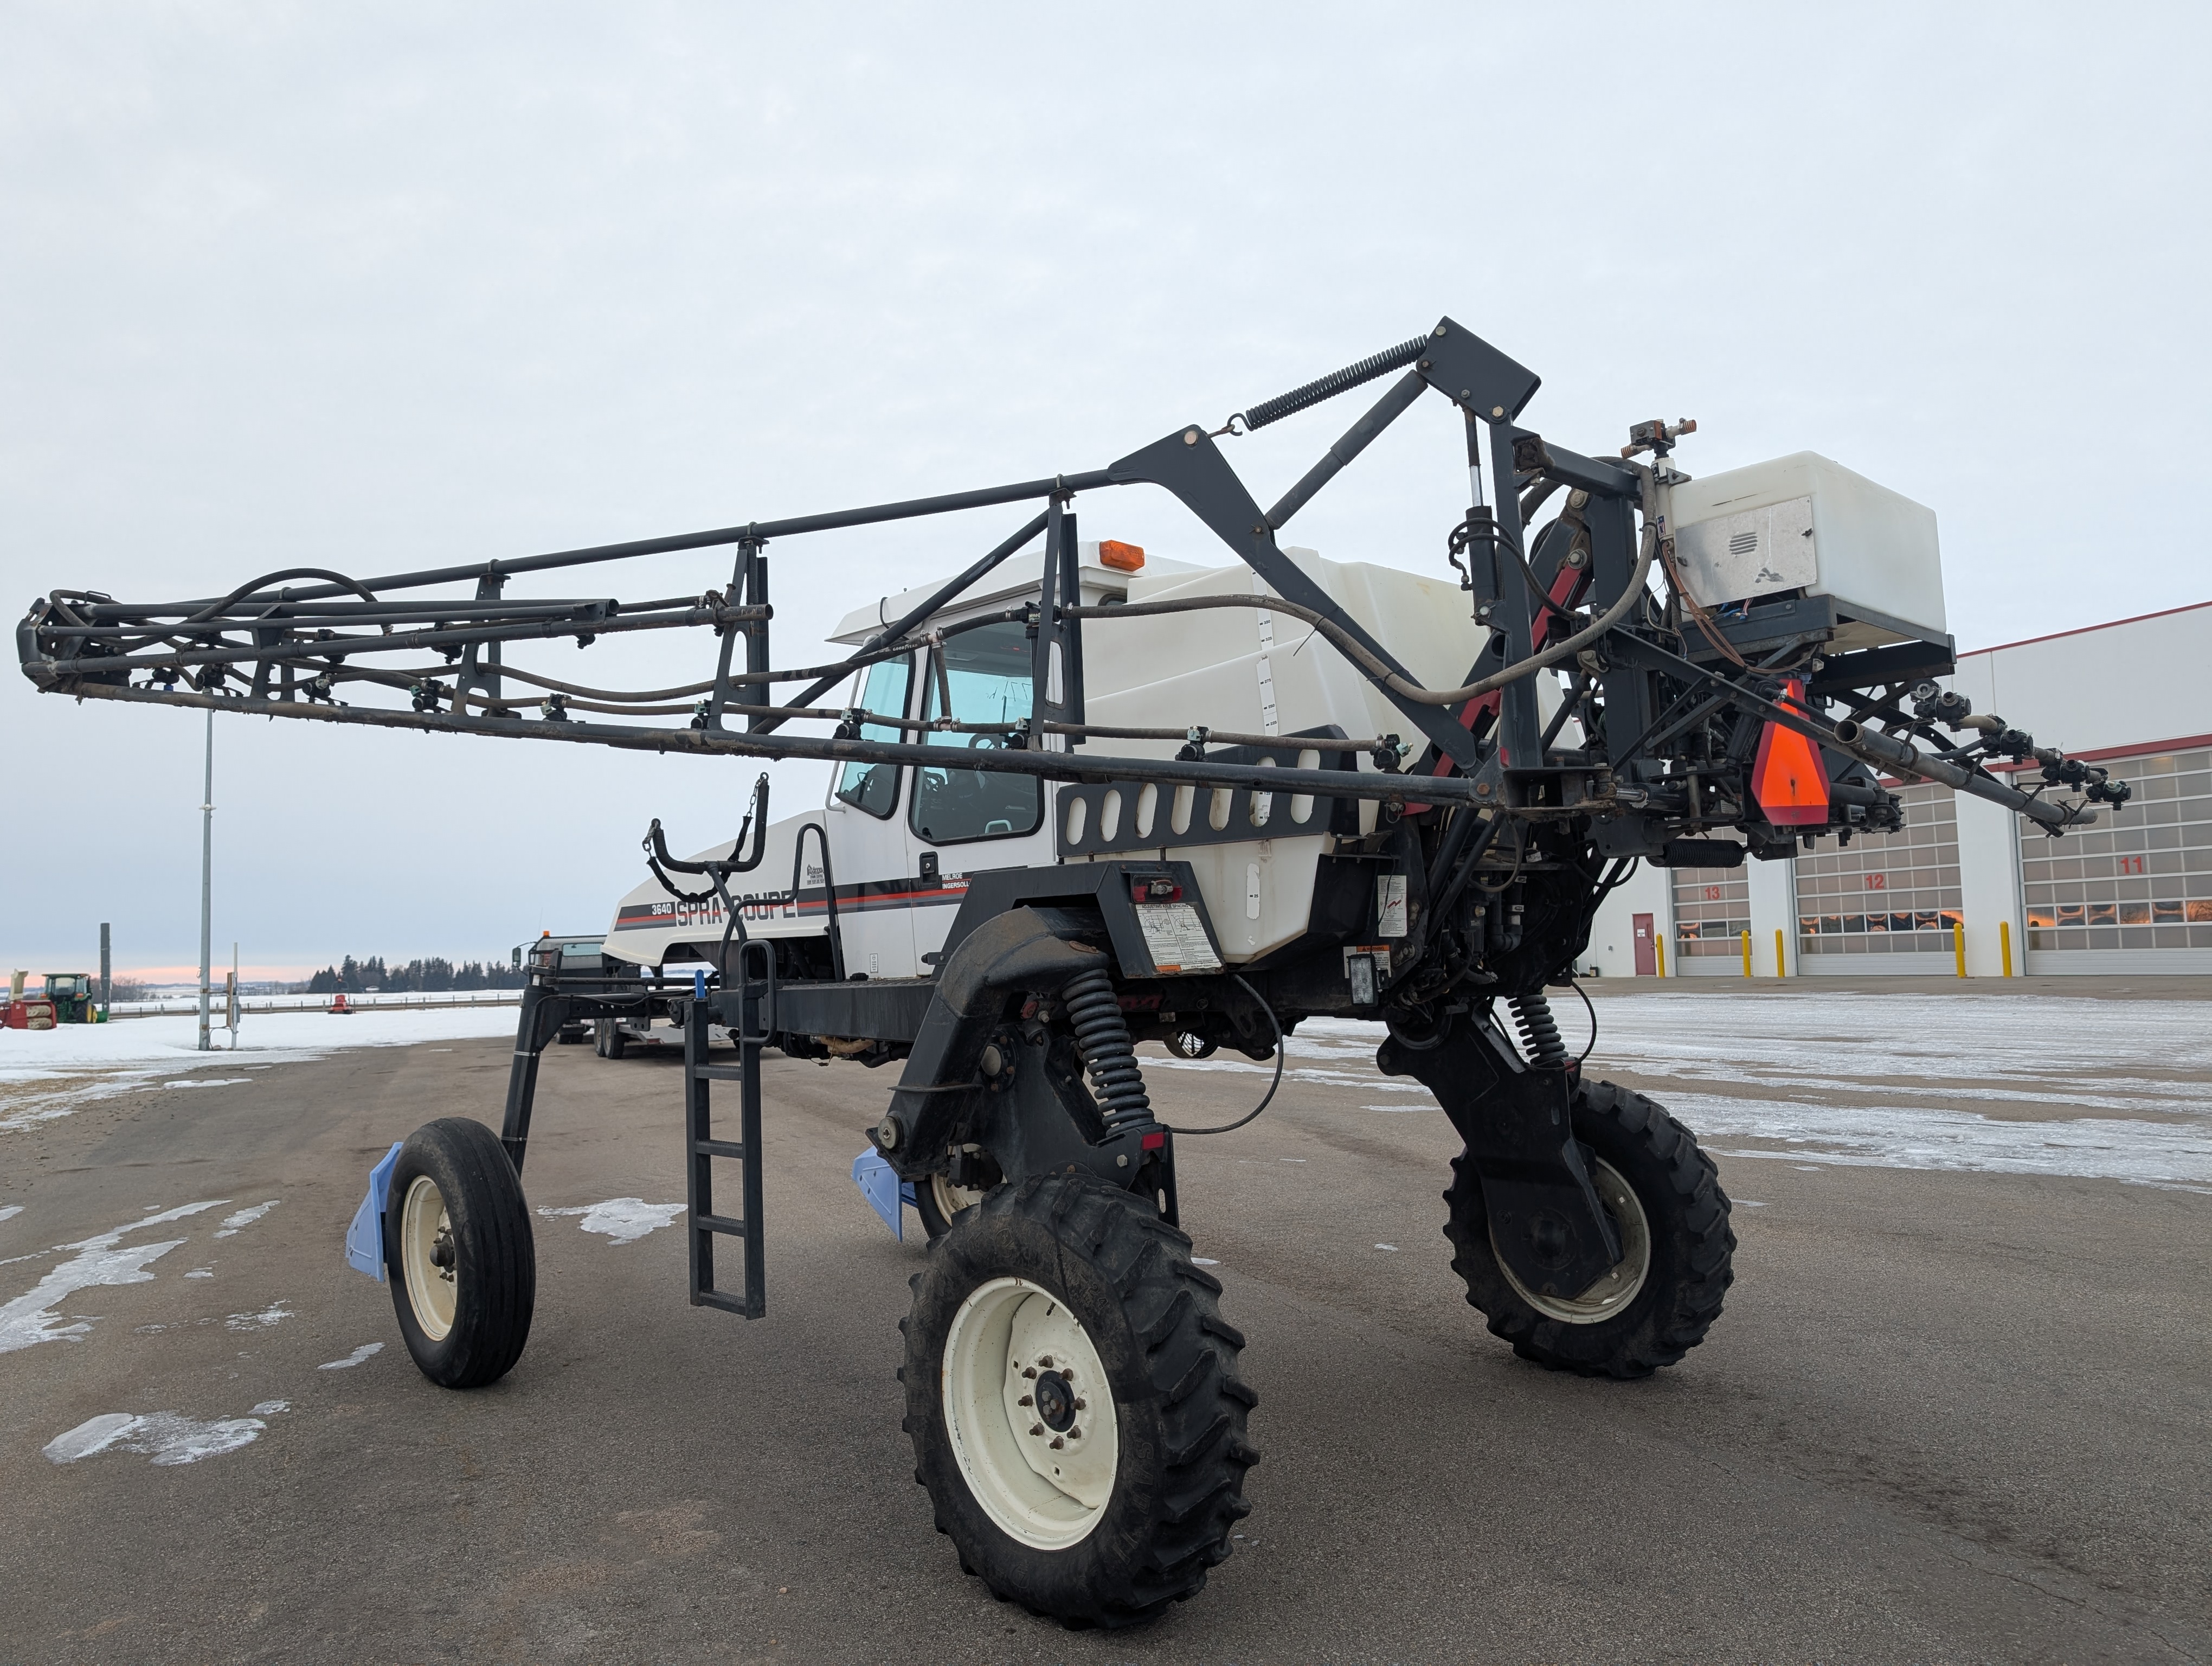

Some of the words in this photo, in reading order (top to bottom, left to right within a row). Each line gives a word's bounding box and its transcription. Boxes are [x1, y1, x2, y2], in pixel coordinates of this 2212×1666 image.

[2120, 856, 2143, 874] 11
[942, 873, 963, 881] MELROE
[1866, 874, 1885, 889] 12
[1705, 886, 1720, 900] 13
[652, 903, 672, 915] 3640
